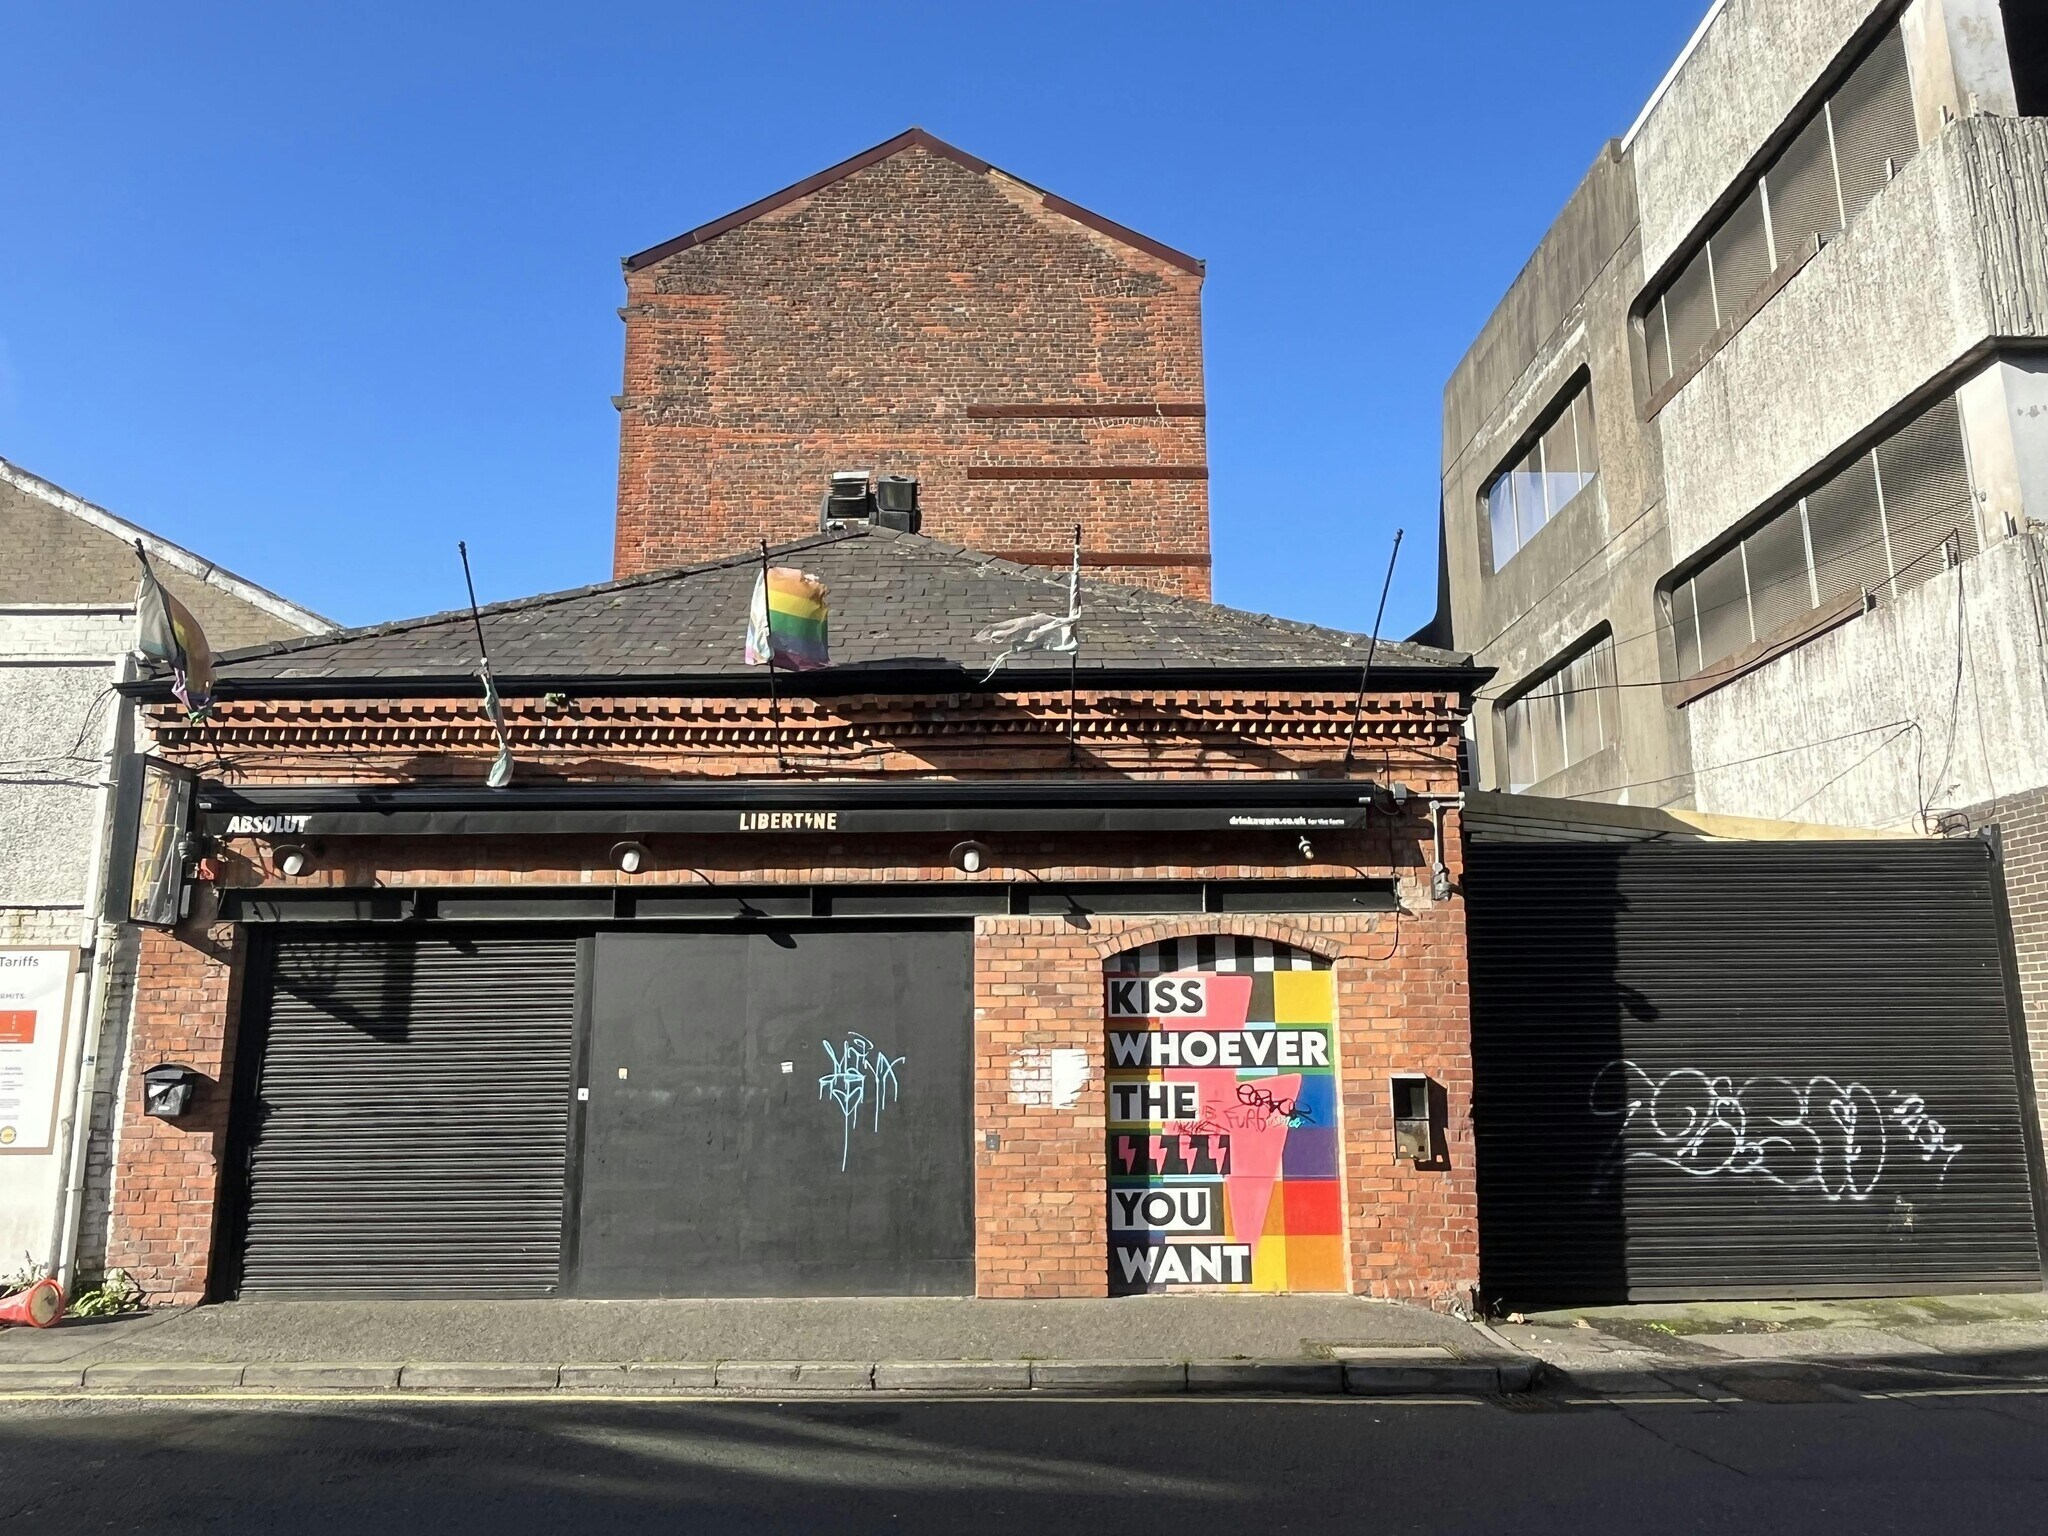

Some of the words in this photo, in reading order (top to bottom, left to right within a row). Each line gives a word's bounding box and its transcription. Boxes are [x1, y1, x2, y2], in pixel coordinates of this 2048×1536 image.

[226, 815, 312, 834] ABSOLUT
[0, 956, 39, 967] Tariffs
[1111, 980, 1203, 1014] KISS
[1109, 1031, 1330, 1066] WHOEVER
[1113, 1085, 1196, 1119] THE
[1115, 1191, 1207, 1226] YOU
[1117, 1245, 1249, 1284] WANT
